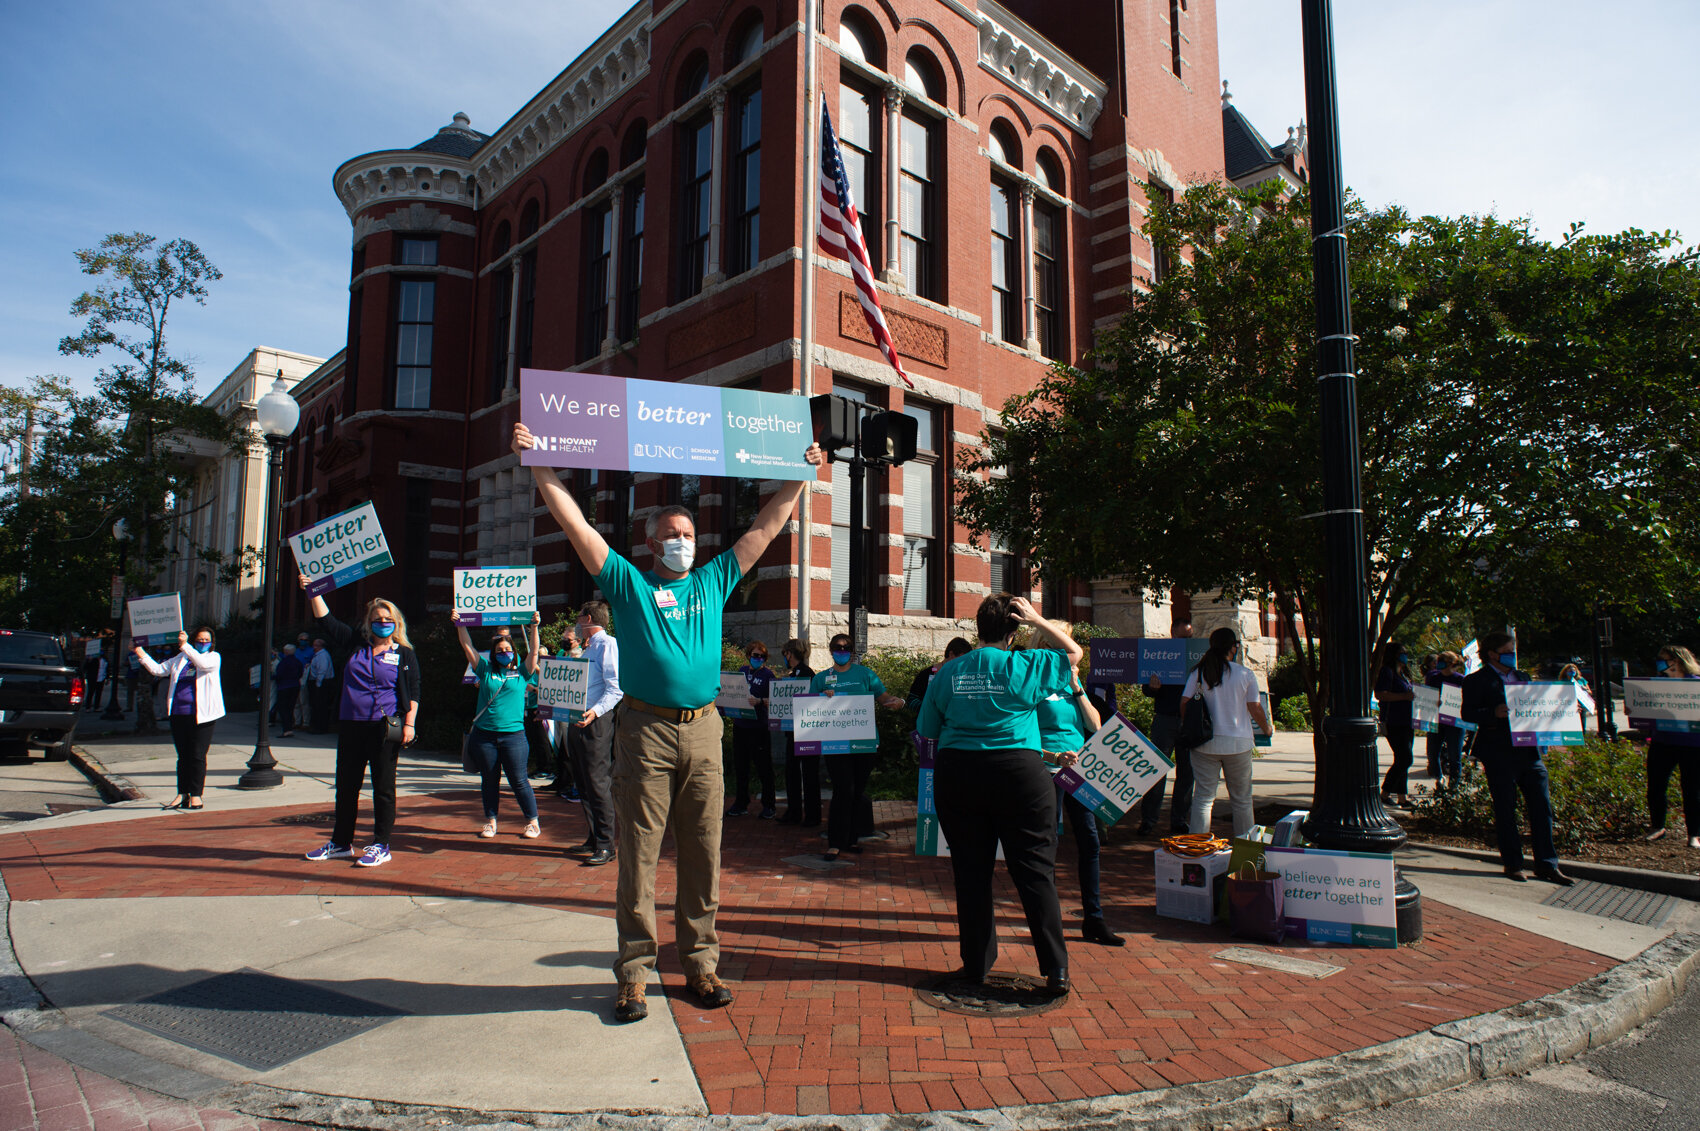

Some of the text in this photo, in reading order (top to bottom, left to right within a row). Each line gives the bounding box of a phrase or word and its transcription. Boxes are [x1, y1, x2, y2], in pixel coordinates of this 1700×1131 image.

[540, 392, 804, 434] We are better together
[559, 436, 598, 447] NOVANT
[559, 444, 594, 453] HEALTH
[645, 444, 684, 460] UNC
[690, 447, 711, 455] SCHOOL
[298, 514, 367, 554] better
[299, 532, 382, 575] together
[462, 571, 528, 589] better
[456, 590, 535, 611] together
[1098, 648, 1117, 659] We
[1118, 650, 1135, 660] are
[1143, 648, 1181, 660] better
[543, 661, 583, 682] better
[538, 684, 586, 705] together
[773, 682, 806, 698] better
[1638, 690, 1672, 699] believe
[1518, 697, 1546, 706] believe
[1632, 699, 1700, 710] better togeth
[768, 702, 793, 718] toget
[806, 708, 837, 717] believe
[853, 708, 867, 716] are
[1514, 708, 1575, 720] better together
[800, 719, 831, 729] better
[832, 718, 869, 729] together
[1101, 723, 1158, 778] better
[1077, 742, 1142, 805] together
[1285, 869, 1331, 885] believe
[1334, 877, 1355, 887] we
[1358, 878, 1380, 889] are
[1284, 887, 1384, 906] etter together
